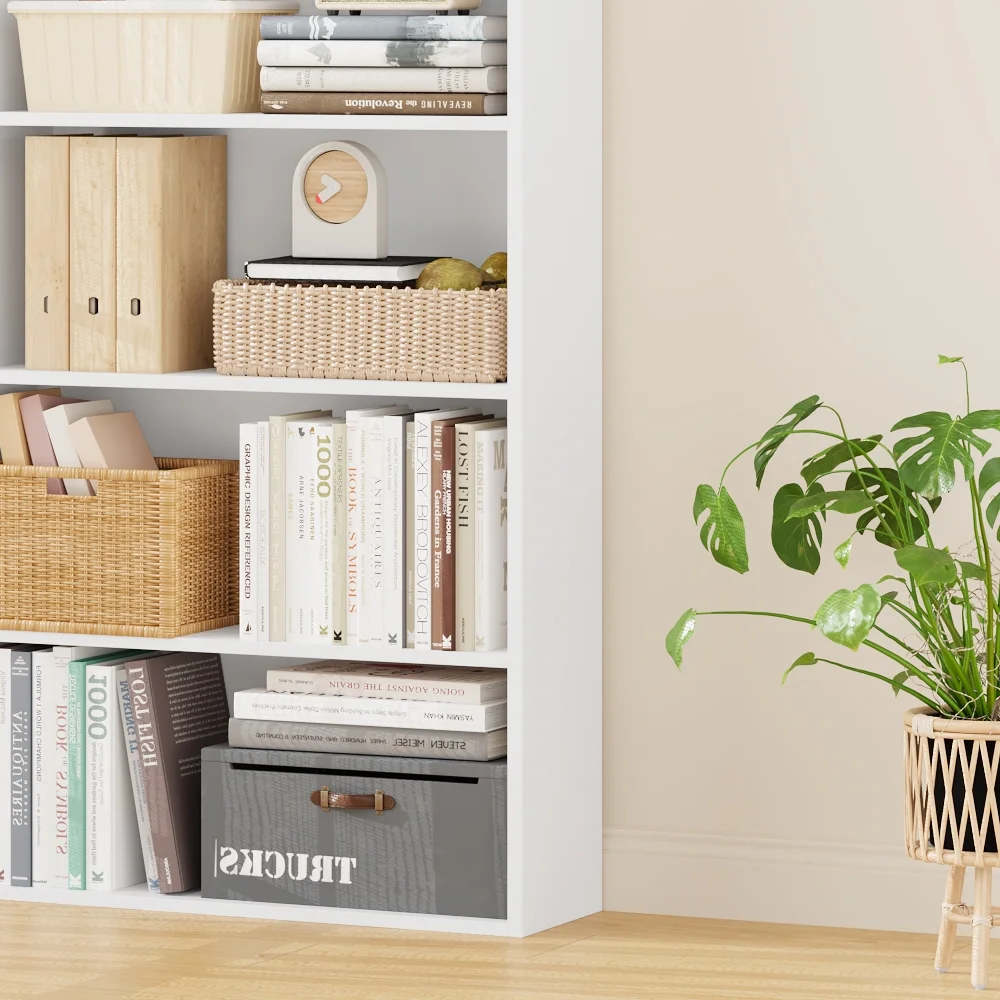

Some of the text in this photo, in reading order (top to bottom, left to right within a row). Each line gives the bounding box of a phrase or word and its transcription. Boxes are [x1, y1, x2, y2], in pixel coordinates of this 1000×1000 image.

[345, 99, 472, 110] REVEALING the Revolution
[317, 434, 331, 498] 1000
[458, 431, 469, 527] LOST FISH
[417, 420, 428, 634] ALEXEY BRODOVITCH
[434, 490, 442, 588] Gardens in France
[329, 681, 465, 696] GOING AGAINST THE GRAIN
[424, 712, 444, 720] KHAN
